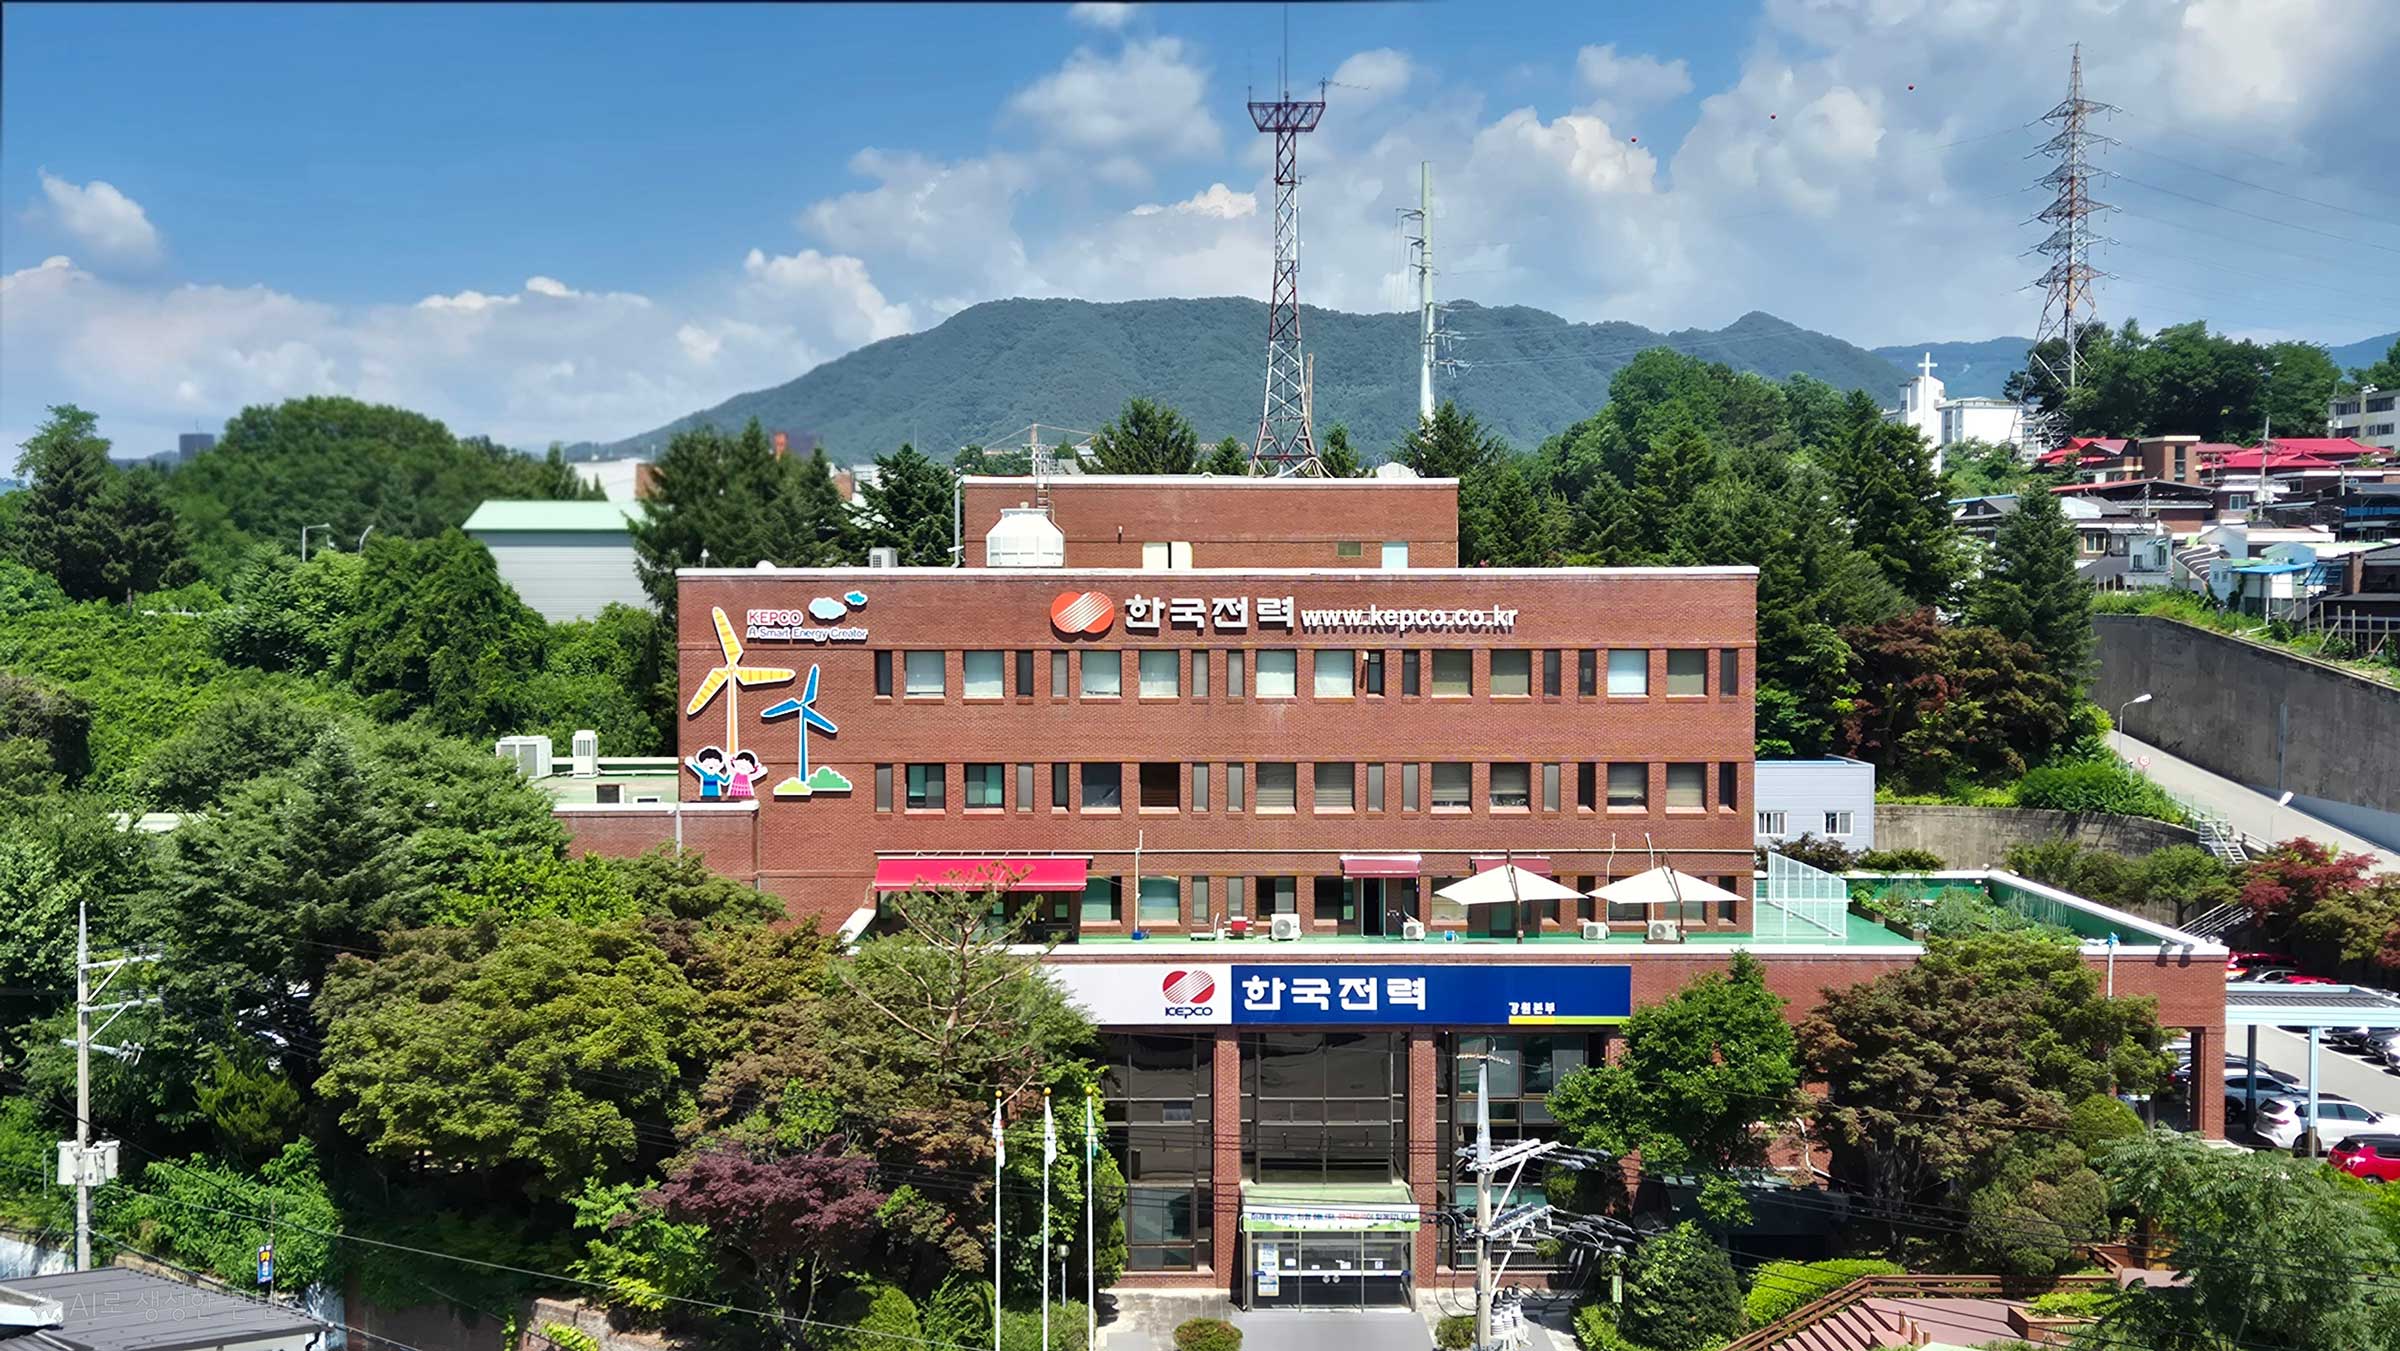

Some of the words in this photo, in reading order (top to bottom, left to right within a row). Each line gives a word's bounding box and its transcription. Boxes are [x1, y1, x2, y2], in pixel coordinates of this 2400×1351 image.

[748, 610, 803, 625] KEPCO
[1125, 594, 1294, 629] 한국전력
[1301, 604, 1518, 632] www.kepco.co.kr
[748, 628, 757, 638] A
[760, 628, 790, 638] Smart
[793, 628, 828, 641] Energy
[830, 628, 867, 639] Creator
[1241, 975, 1427, 1012] 한국전력
[1164, 1006, 1213, 1019] KEPCO
[1508, 1001, 1556, 1015] 강원본부
